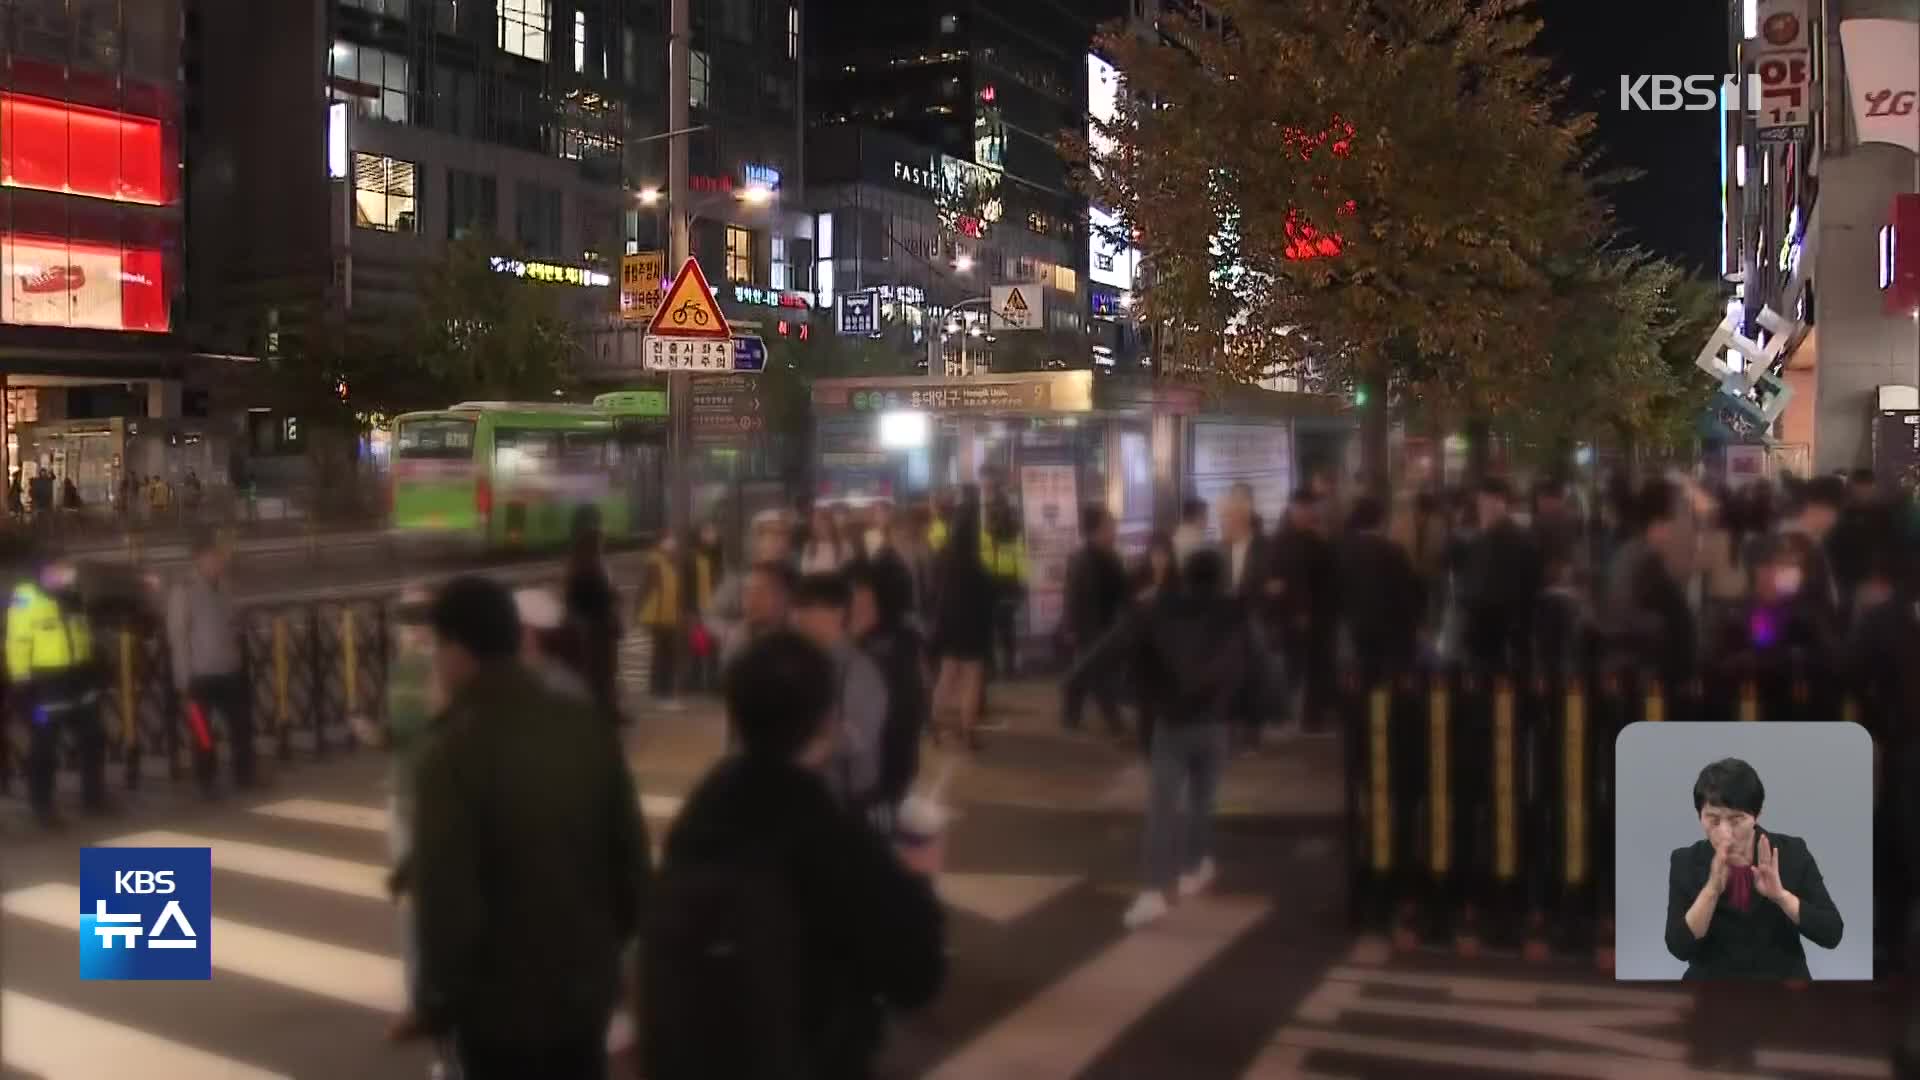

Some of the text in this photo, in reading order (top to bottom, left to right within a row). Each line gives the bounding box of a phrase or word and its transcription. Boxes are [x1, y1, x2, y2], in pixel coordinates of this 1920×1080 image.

[1759, 60, 1806, 107] 약
[1865, 88, 1917, 118] LG
[894, 160, 965, 198] FASTFIVE
[911, 390, 961, 409] 홍대입구
